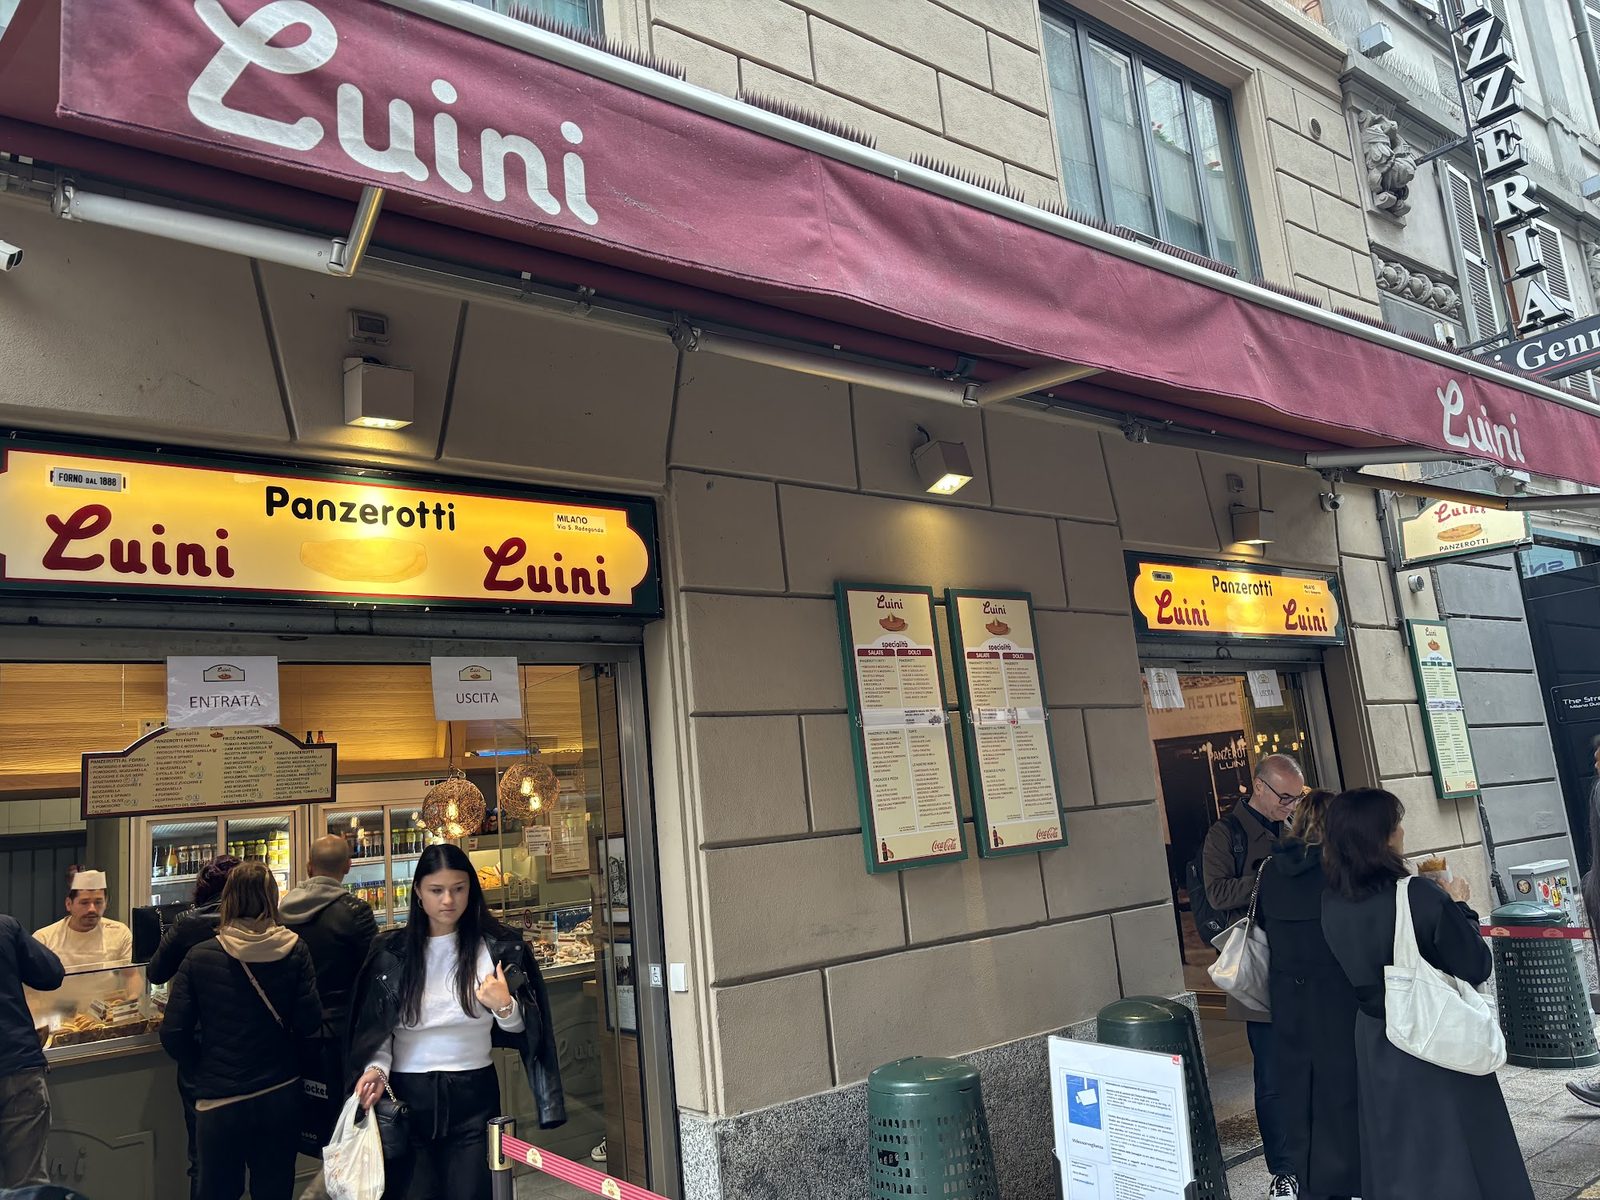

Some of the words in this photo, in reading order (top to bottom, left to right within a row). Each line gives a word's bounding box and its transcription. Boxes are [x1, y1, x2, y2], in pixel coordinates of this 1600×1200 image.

[187, 0, 599, 226] Luini
[1461, 0, 1574, 333] ZZERIA
[1436, 378, 1525, 464] Luini
[58, 472, 83, 484] FORNO
[85, 477, 98, 485] DAL
[99, 477, 117, 487] 1888
[264, 485, 456, 532] Panzerotti
[556, 514, 588, 525] MILANO
[41, 503, 235, 579] Luini
[1439, 537, 1489, 552] PANZEROTTI
[483, 536, 611, 597] Luini
[1212, 575, 1273, 597] Panzerotti
[876, 594, 904, 610] Luini
[982, 600, 1007, 615] Luini
[1154, 589, 1210, 627] Luini
[1282, 598, 1328, 632] Luini
[189, 695, 261, 709] ENTRATA
[456, 692, 499, 704] USCITA
